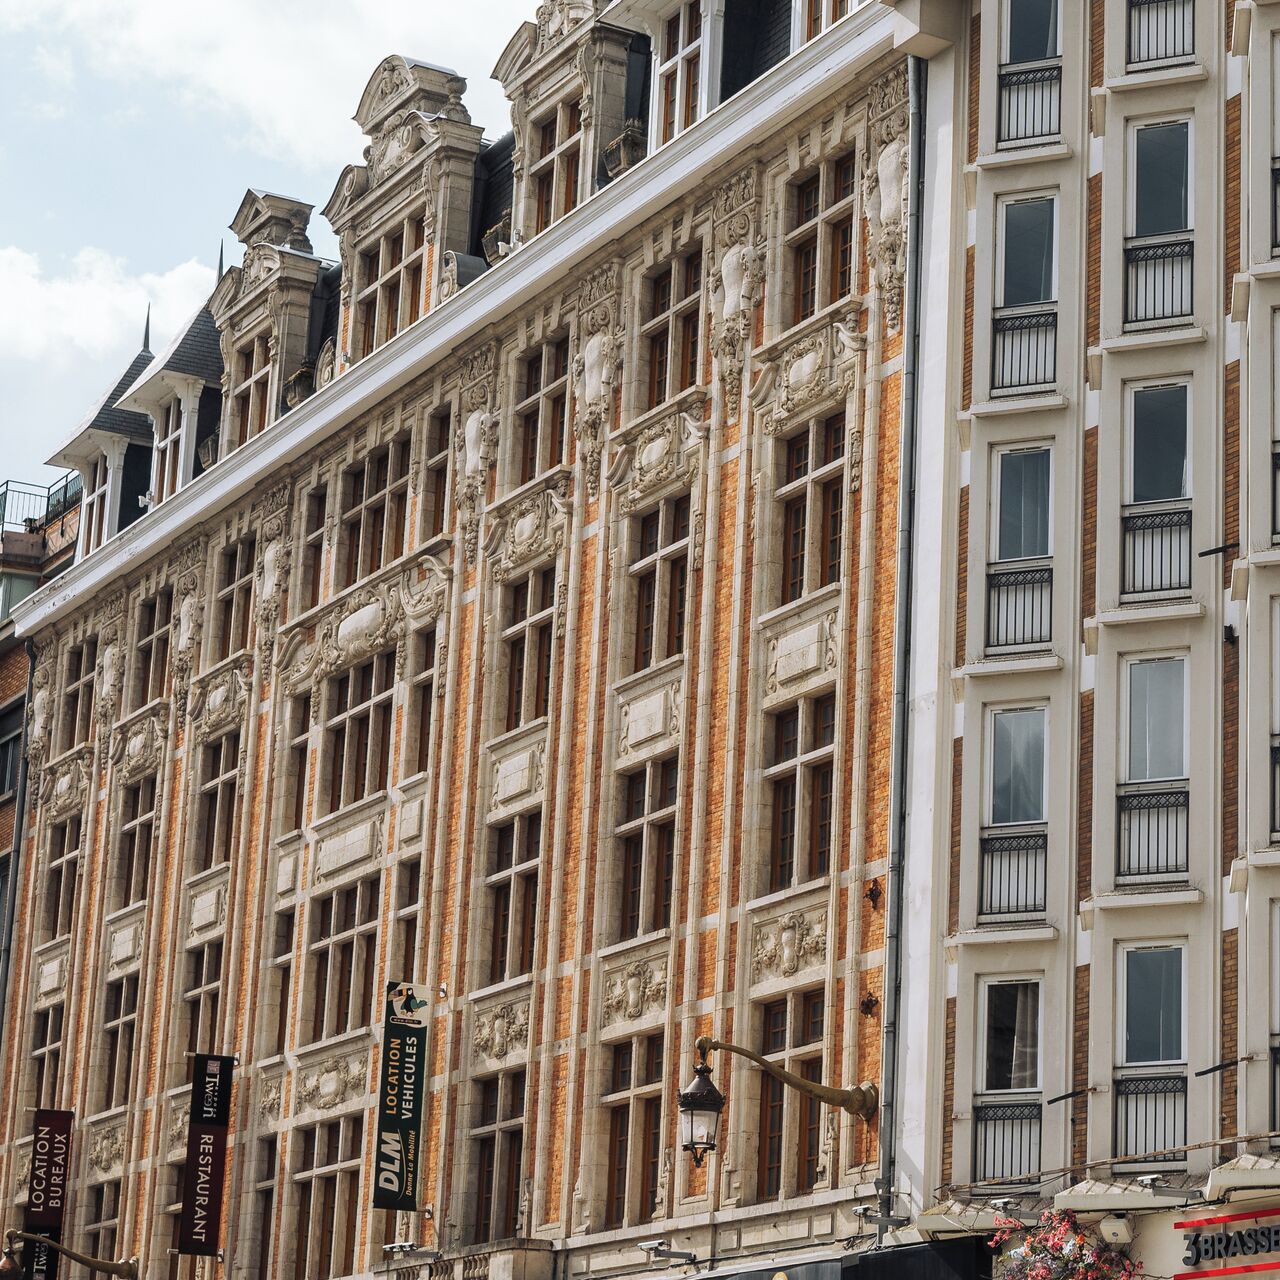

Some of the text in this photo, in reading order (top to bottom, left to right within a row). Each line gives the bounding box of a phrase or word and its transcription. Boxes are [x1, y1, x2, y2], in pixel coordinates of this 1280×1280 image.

[385, 1038, 401, 1115] LOCATION
[401, 1036, 417, 1119] VEHICULES
[31, 1126, 50, 1212] LOCATION
[48, 1133, 67, 1208] BUREAUX
[379, 1131, 401, 1193] DLM
[407, 1130, 416, 1160] Mobilité
[192, 1134, 214, 1243] RESTAURANT
[405, 1172, 413, 1196] Donne
